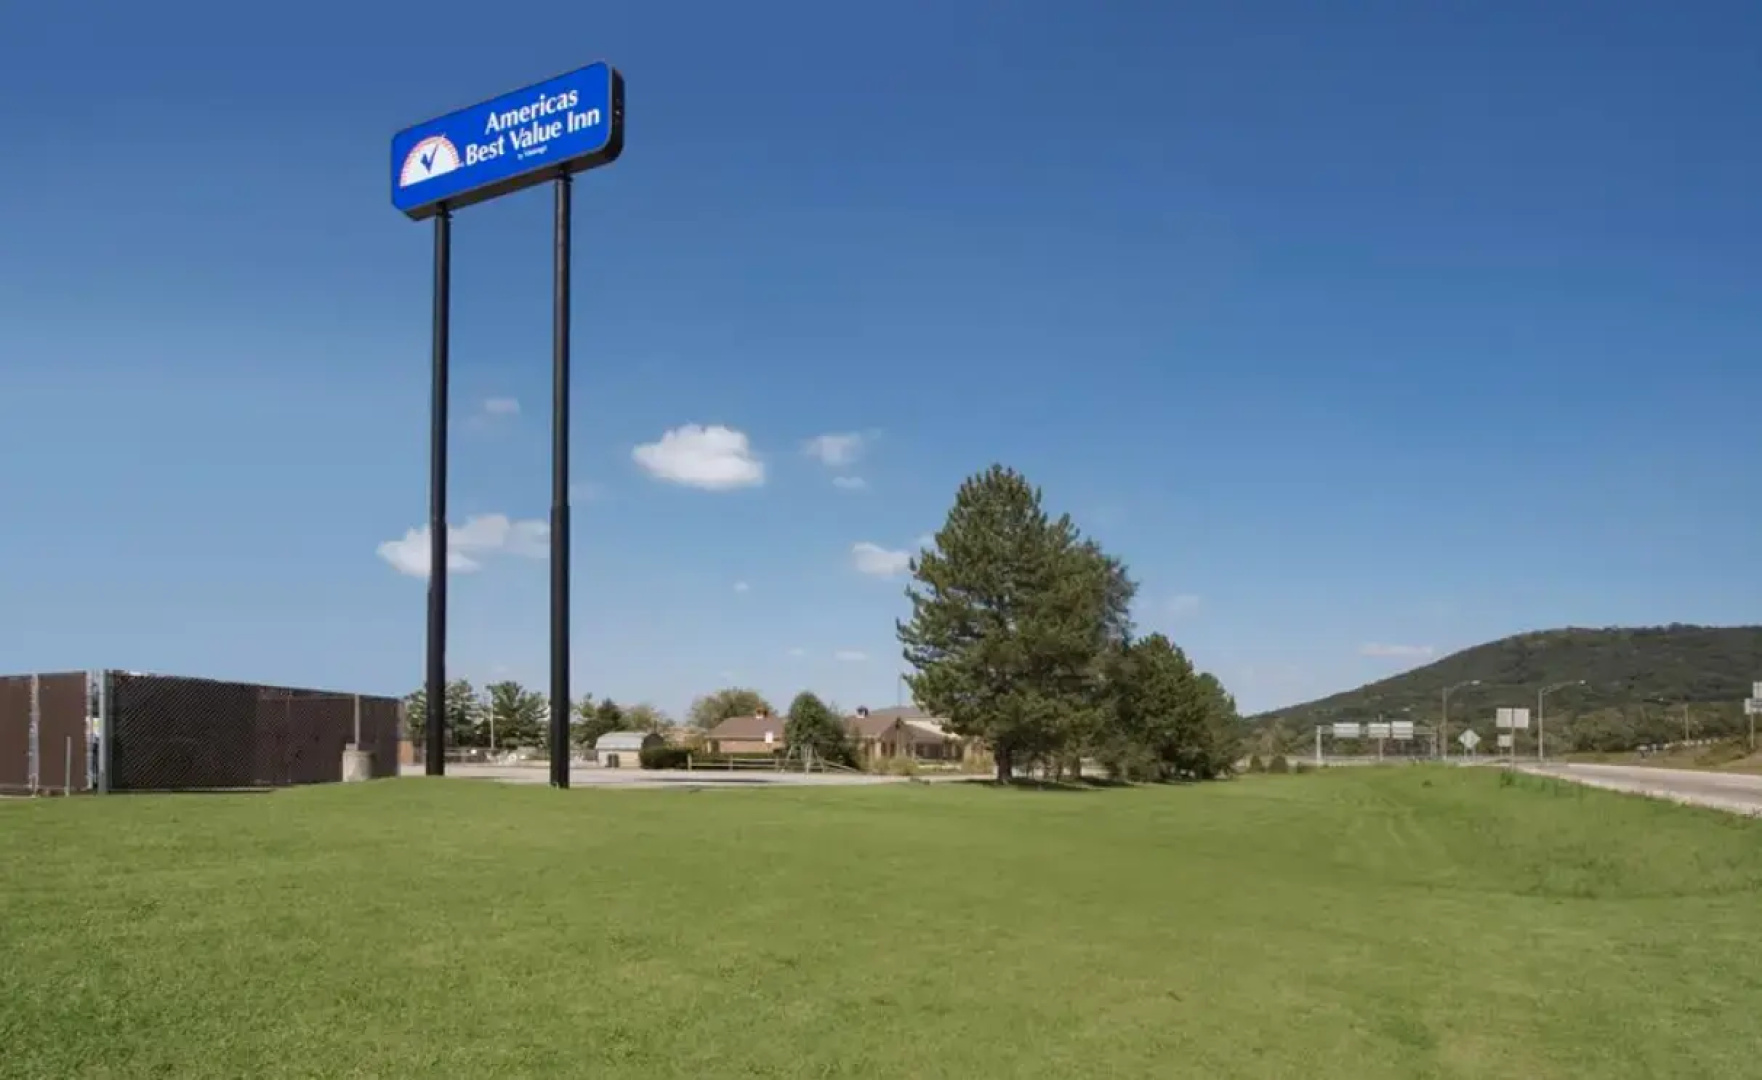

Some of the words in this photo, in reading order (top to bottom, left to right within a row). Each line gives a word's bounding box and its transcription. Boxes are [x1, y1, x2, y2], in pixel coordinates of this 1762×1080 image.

[466, 135, 505, 166] Best
[510, 121, 562, 150] Value
[567, 108, 600, 133] Inn
[485, 89, 578, 135] Americas
